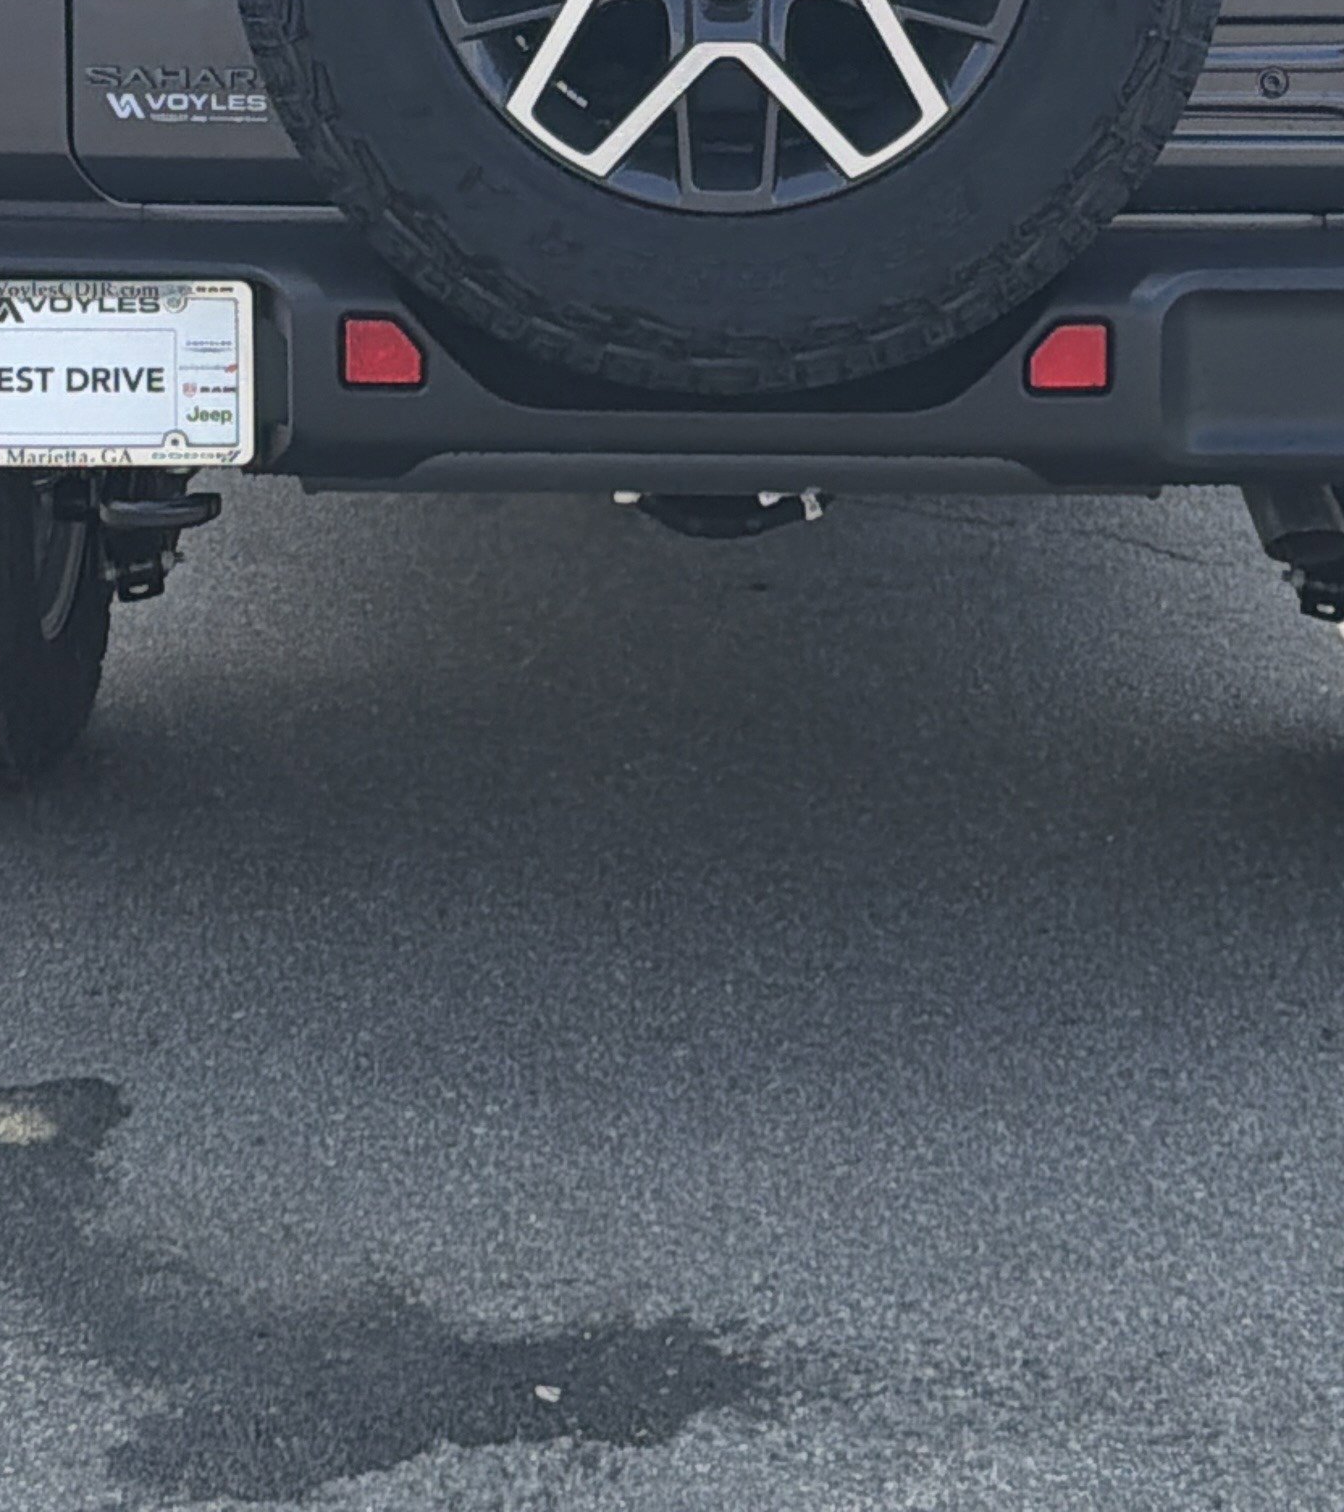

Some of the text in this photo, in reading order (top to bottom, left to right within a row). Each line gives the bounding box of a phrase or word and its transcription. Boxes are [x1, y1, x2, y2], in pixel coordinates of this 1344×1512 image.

[84, 65, 265, 88] SAHAR
[144, 92, 268, 112] VOYLES
[26, 297, 161, 314] VOYLES
[65, 366, 166, 394] DRIVE
[185, 405, 233, 425] Jeep
[100, 447, 133, 464] GA
